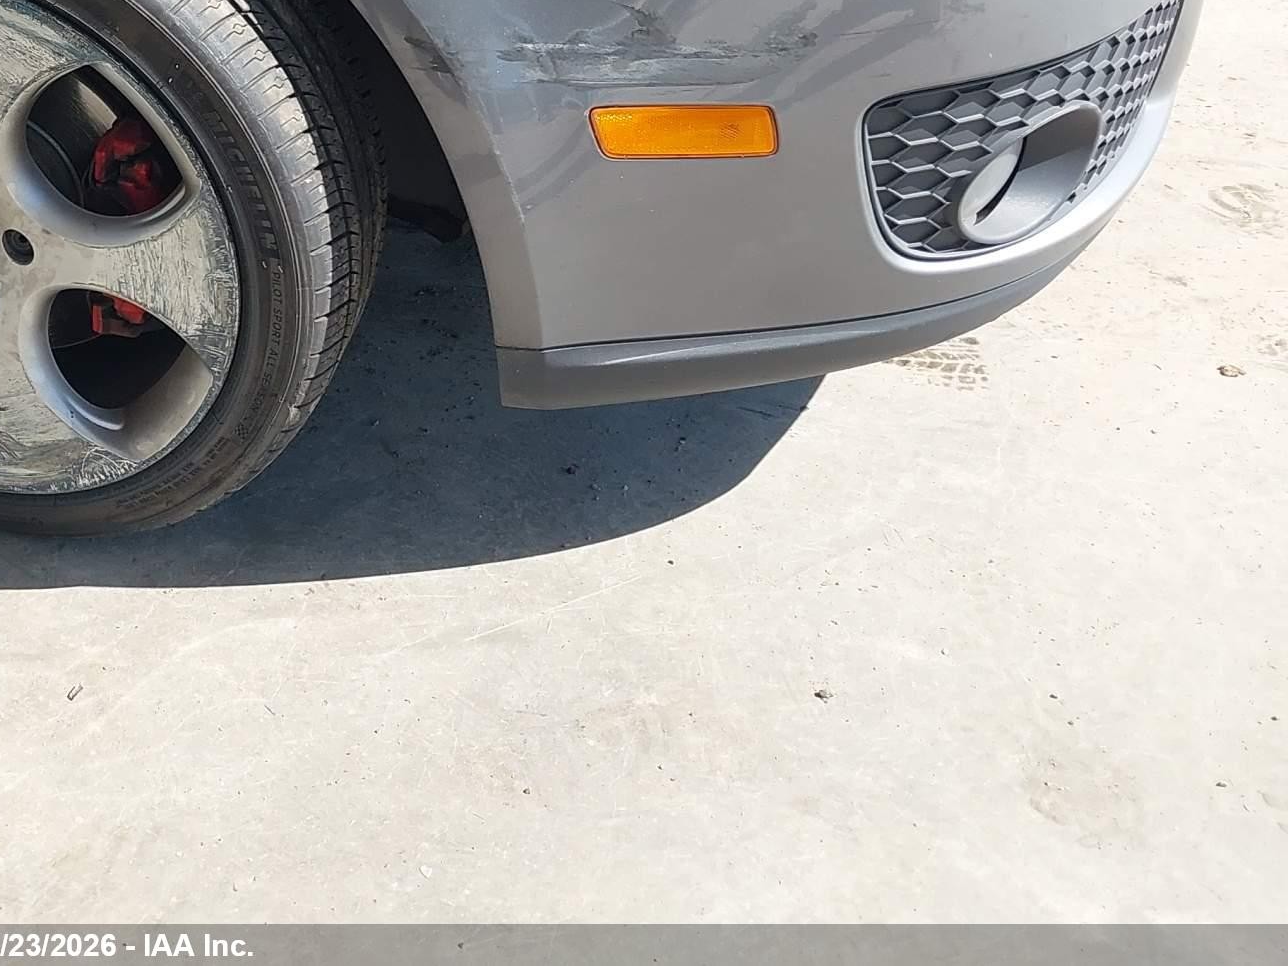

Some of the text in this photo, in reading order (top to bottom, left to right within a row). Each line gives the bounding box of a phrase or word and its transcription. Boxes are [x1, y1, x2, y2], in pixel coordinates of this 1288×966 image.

[202, 108, 282, 252] MICHELIN
[270, 271, 283, 308] PILOT
[269, 310, 283, 347] SPORT
[264, 348, 279, 372] ALL
